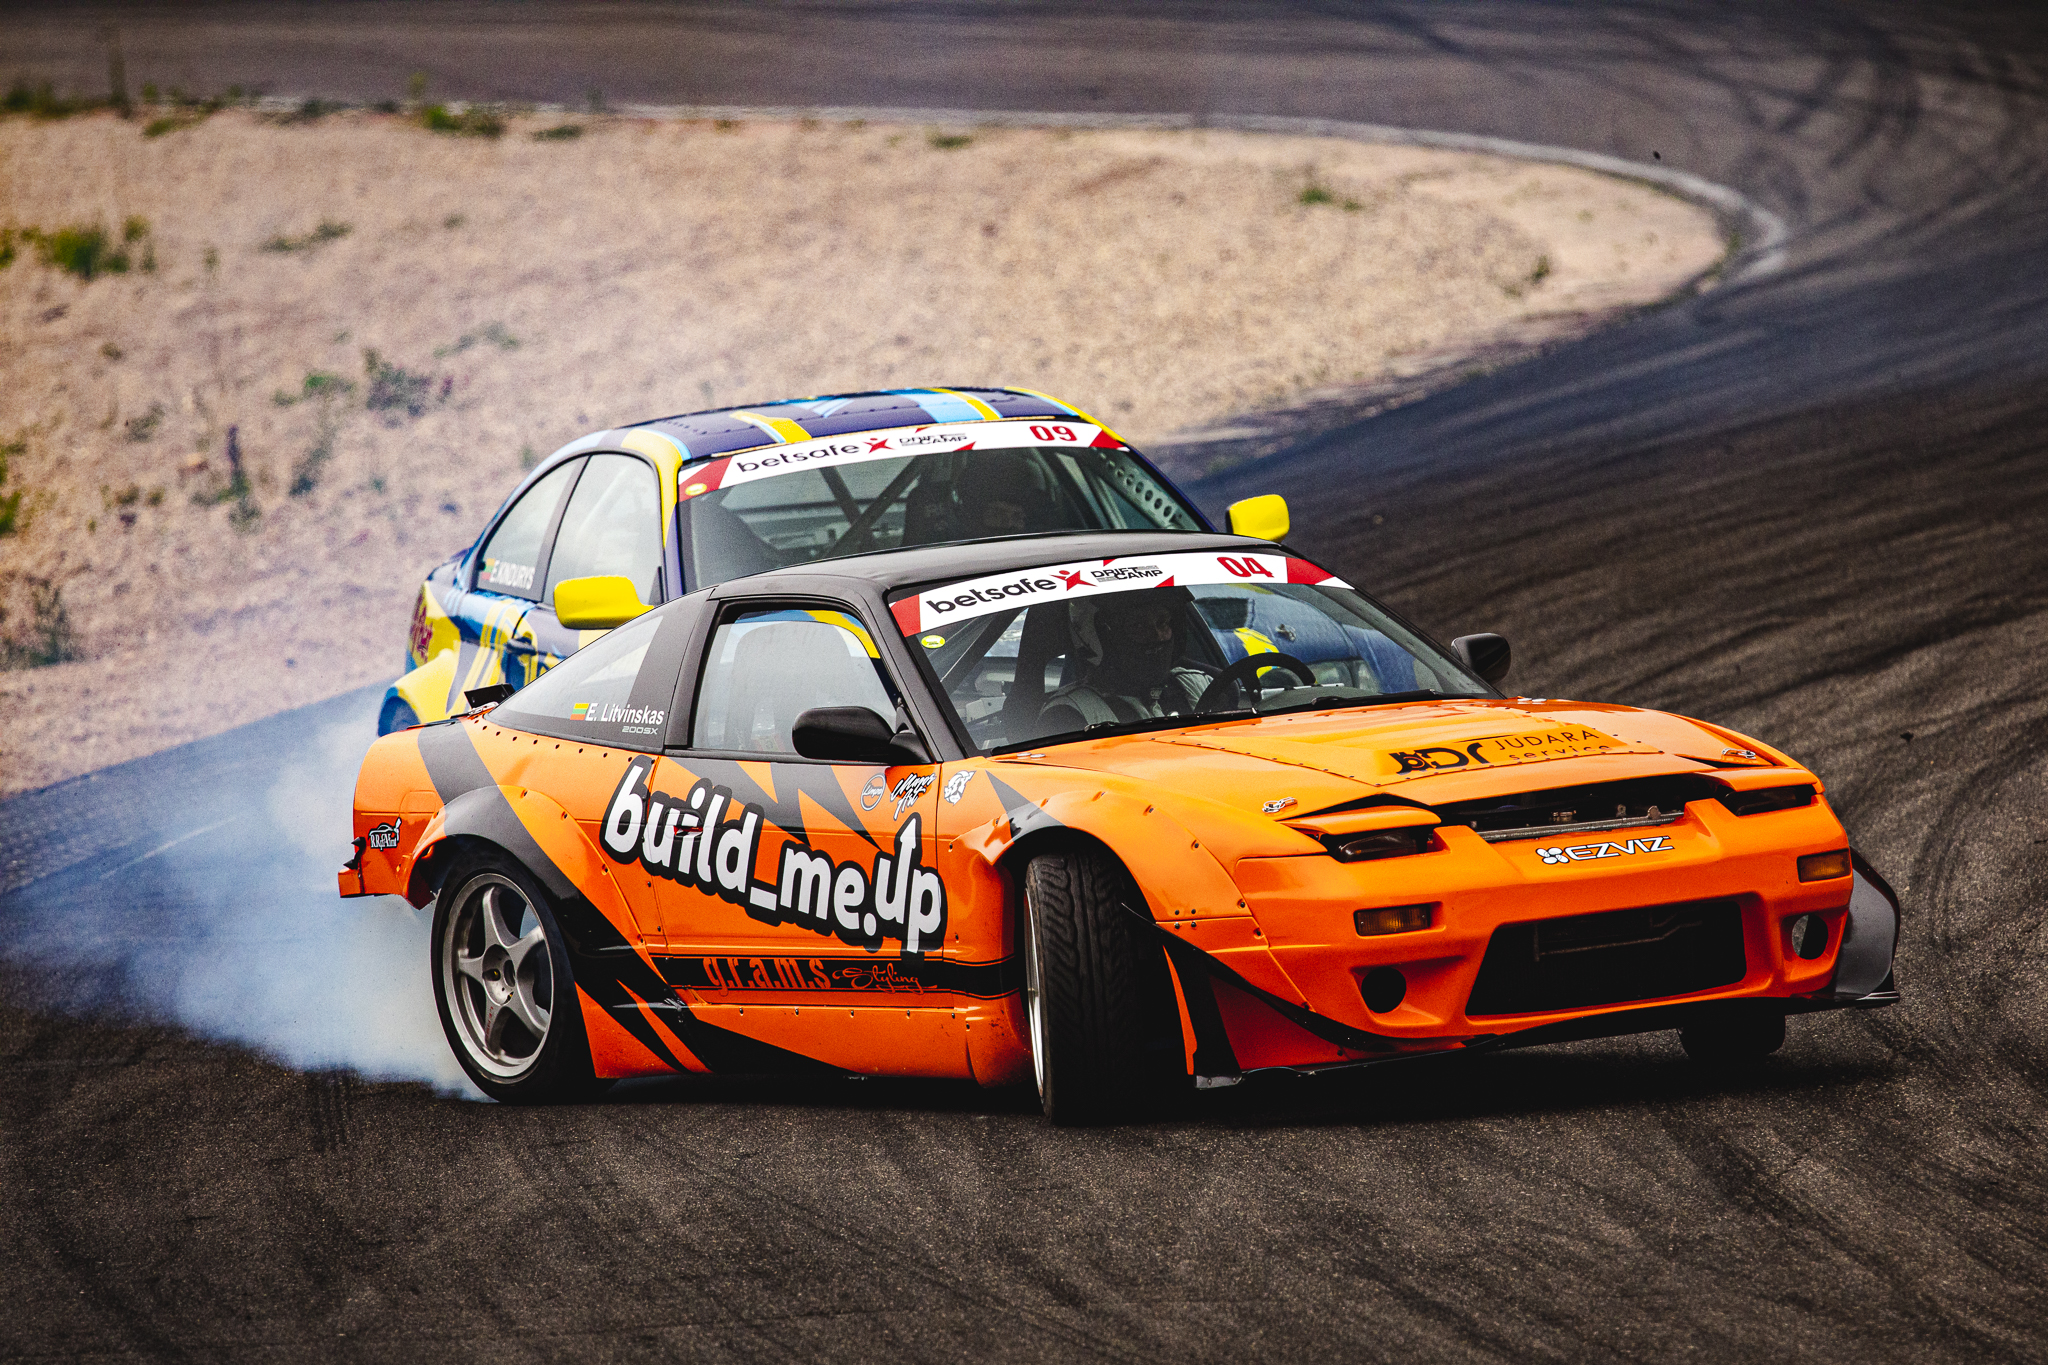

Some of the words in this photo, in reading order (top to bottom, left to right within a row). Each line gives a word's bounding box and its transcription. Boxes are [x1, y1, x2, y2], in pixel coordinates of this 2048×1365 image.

[1029, 425, 1078, 442] 09
[736, 444, 860, 473] betsafe
[1090, 566, 1139, 578] DRIFT
[1113, 569, 1164, 581] CAMP
[1216, 556, 1275, 578] 04
[925, 577, 1058, 614] betsafe
[585, 702, 599, 722] E.
[600, 703, 665, 725] Litvinskas
[621, 725, 659, 735] 200SX
[1493, 729, 1600, 751] JUDARA
[1563, 836, 1676, 861] EZVIZ
